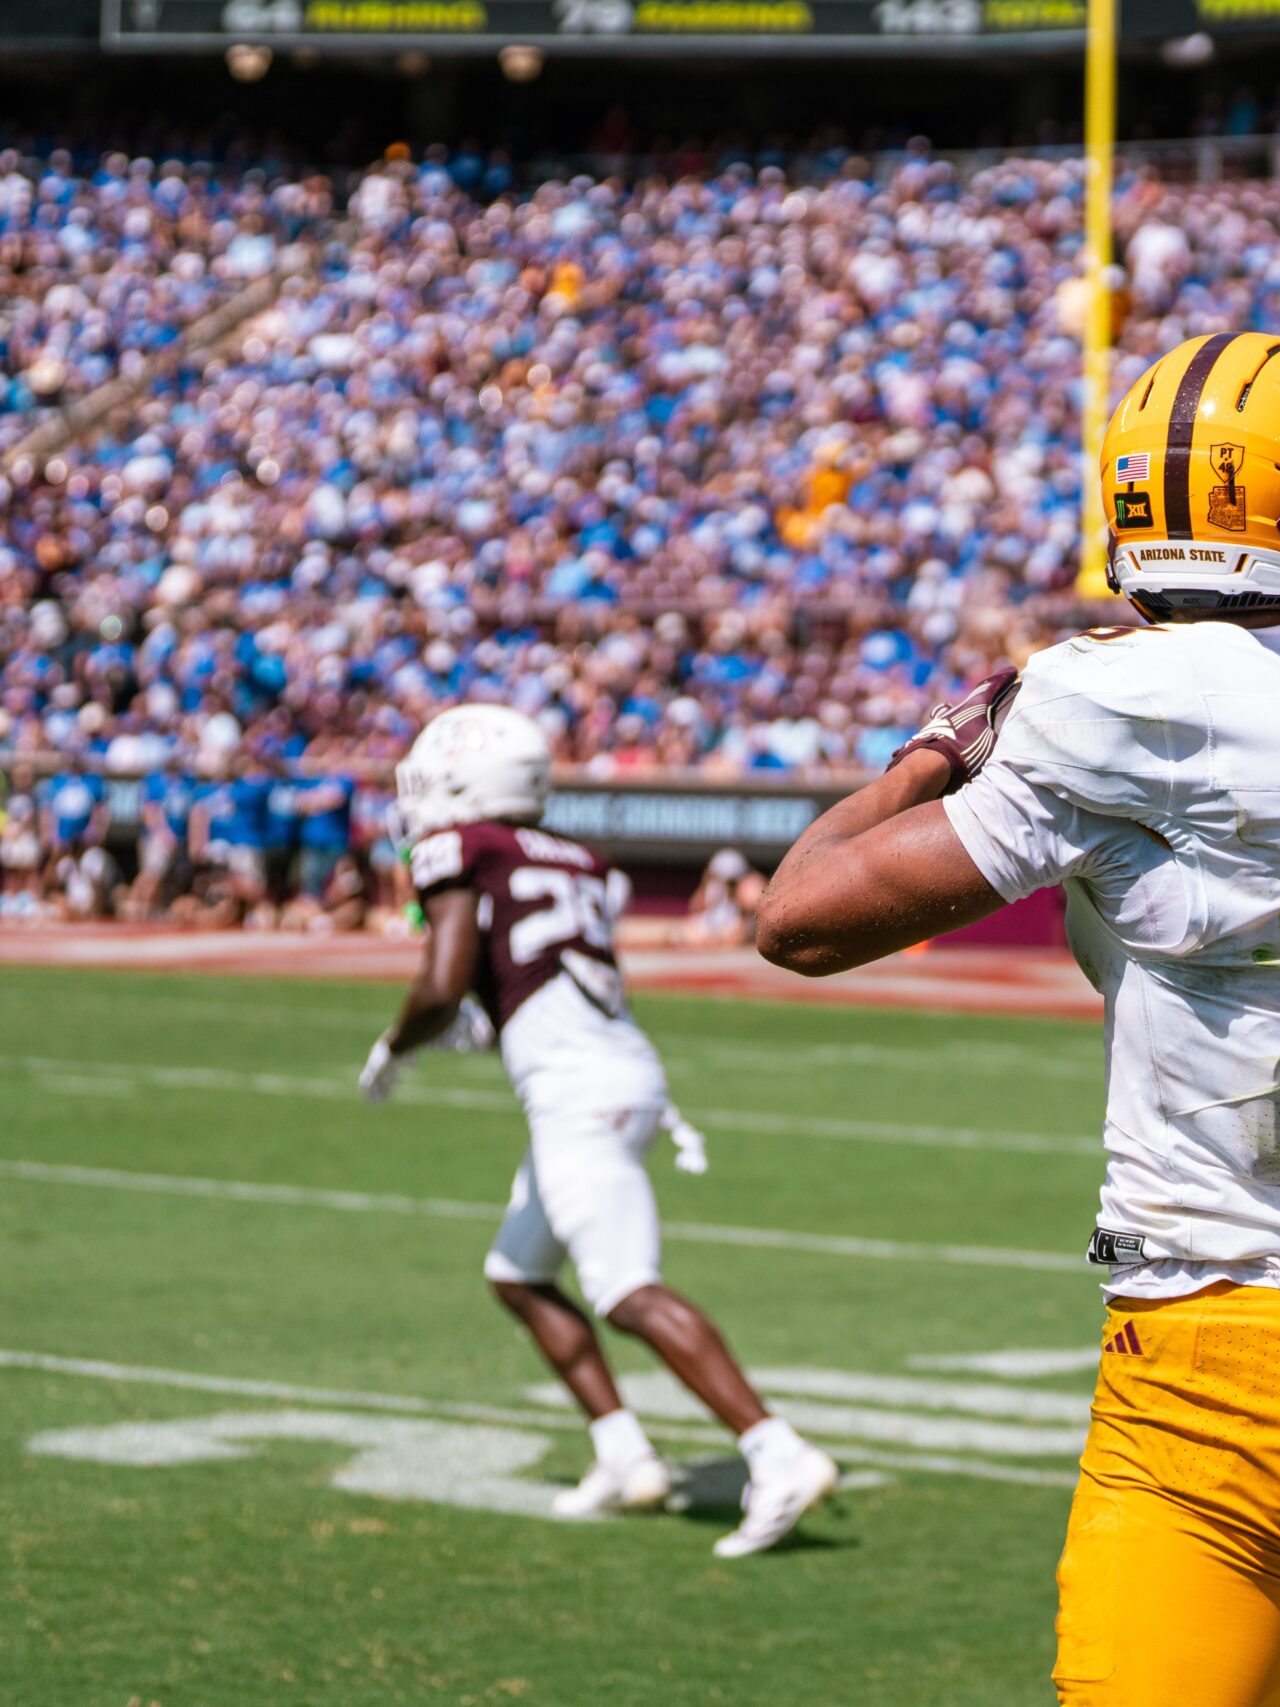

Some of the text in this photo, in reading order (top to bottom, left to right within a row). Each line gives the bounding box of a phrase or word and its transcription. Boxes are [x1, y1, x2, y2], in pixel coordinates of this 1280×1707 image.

[1220, 448, 1234, 459] PT
[1140, 548, 1226, 563] ARIZONA STATE
